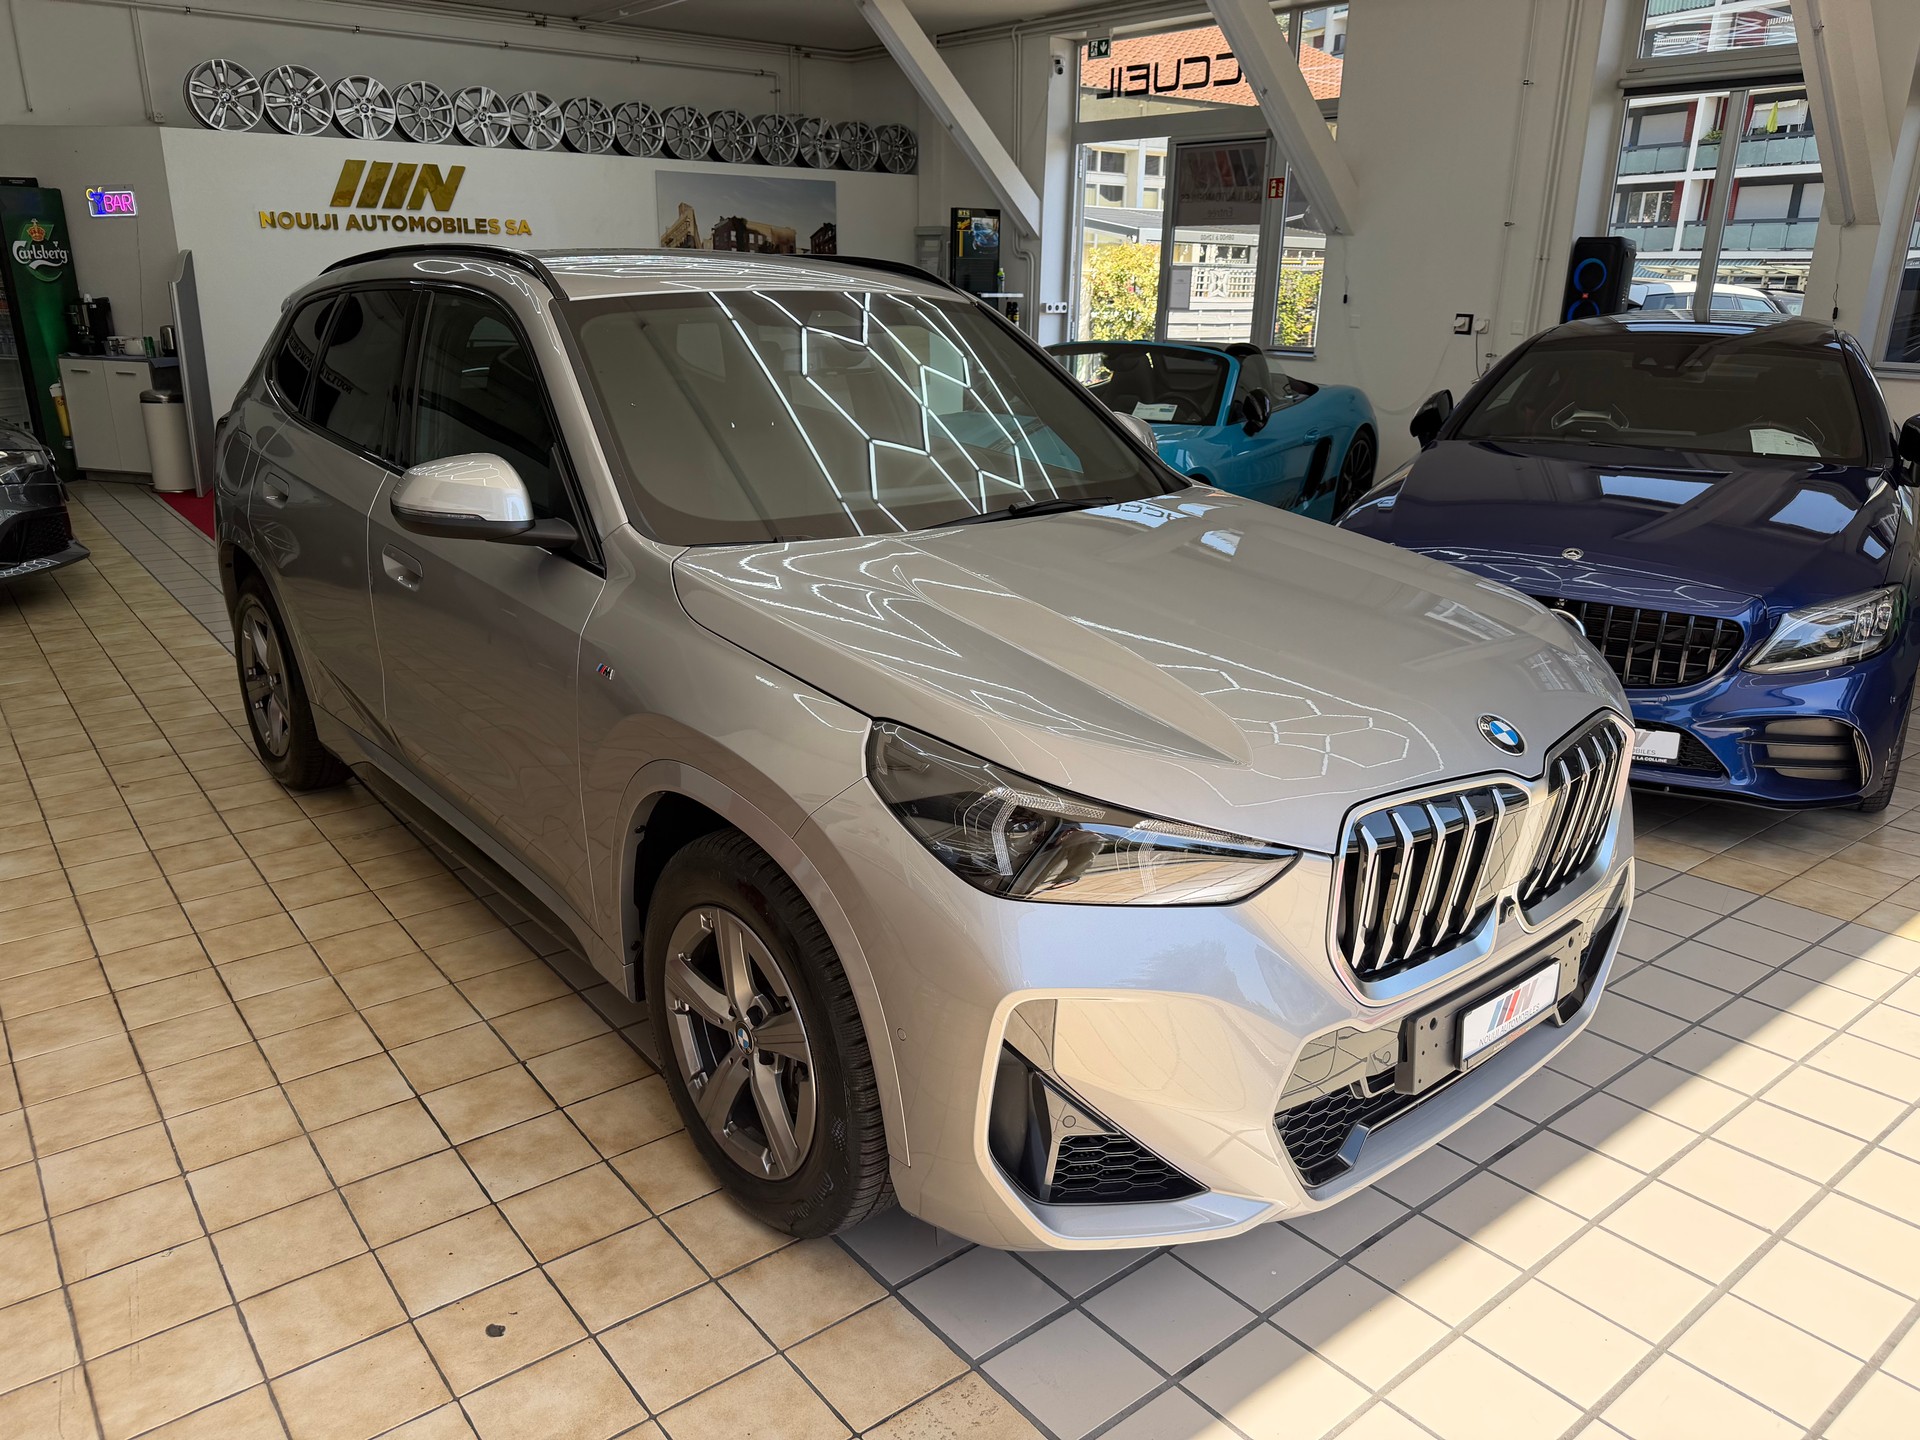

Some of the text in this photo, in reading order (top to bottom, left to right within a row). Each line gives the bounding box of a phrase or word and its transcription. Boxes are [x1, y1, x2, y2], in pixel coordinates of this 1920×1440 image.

[103, 194, 134, 213] BAR
[258, 210, 532, 236] NOUIJI AUTOMOBILES SA
[12, 240, 69, 267] Carlsberg
